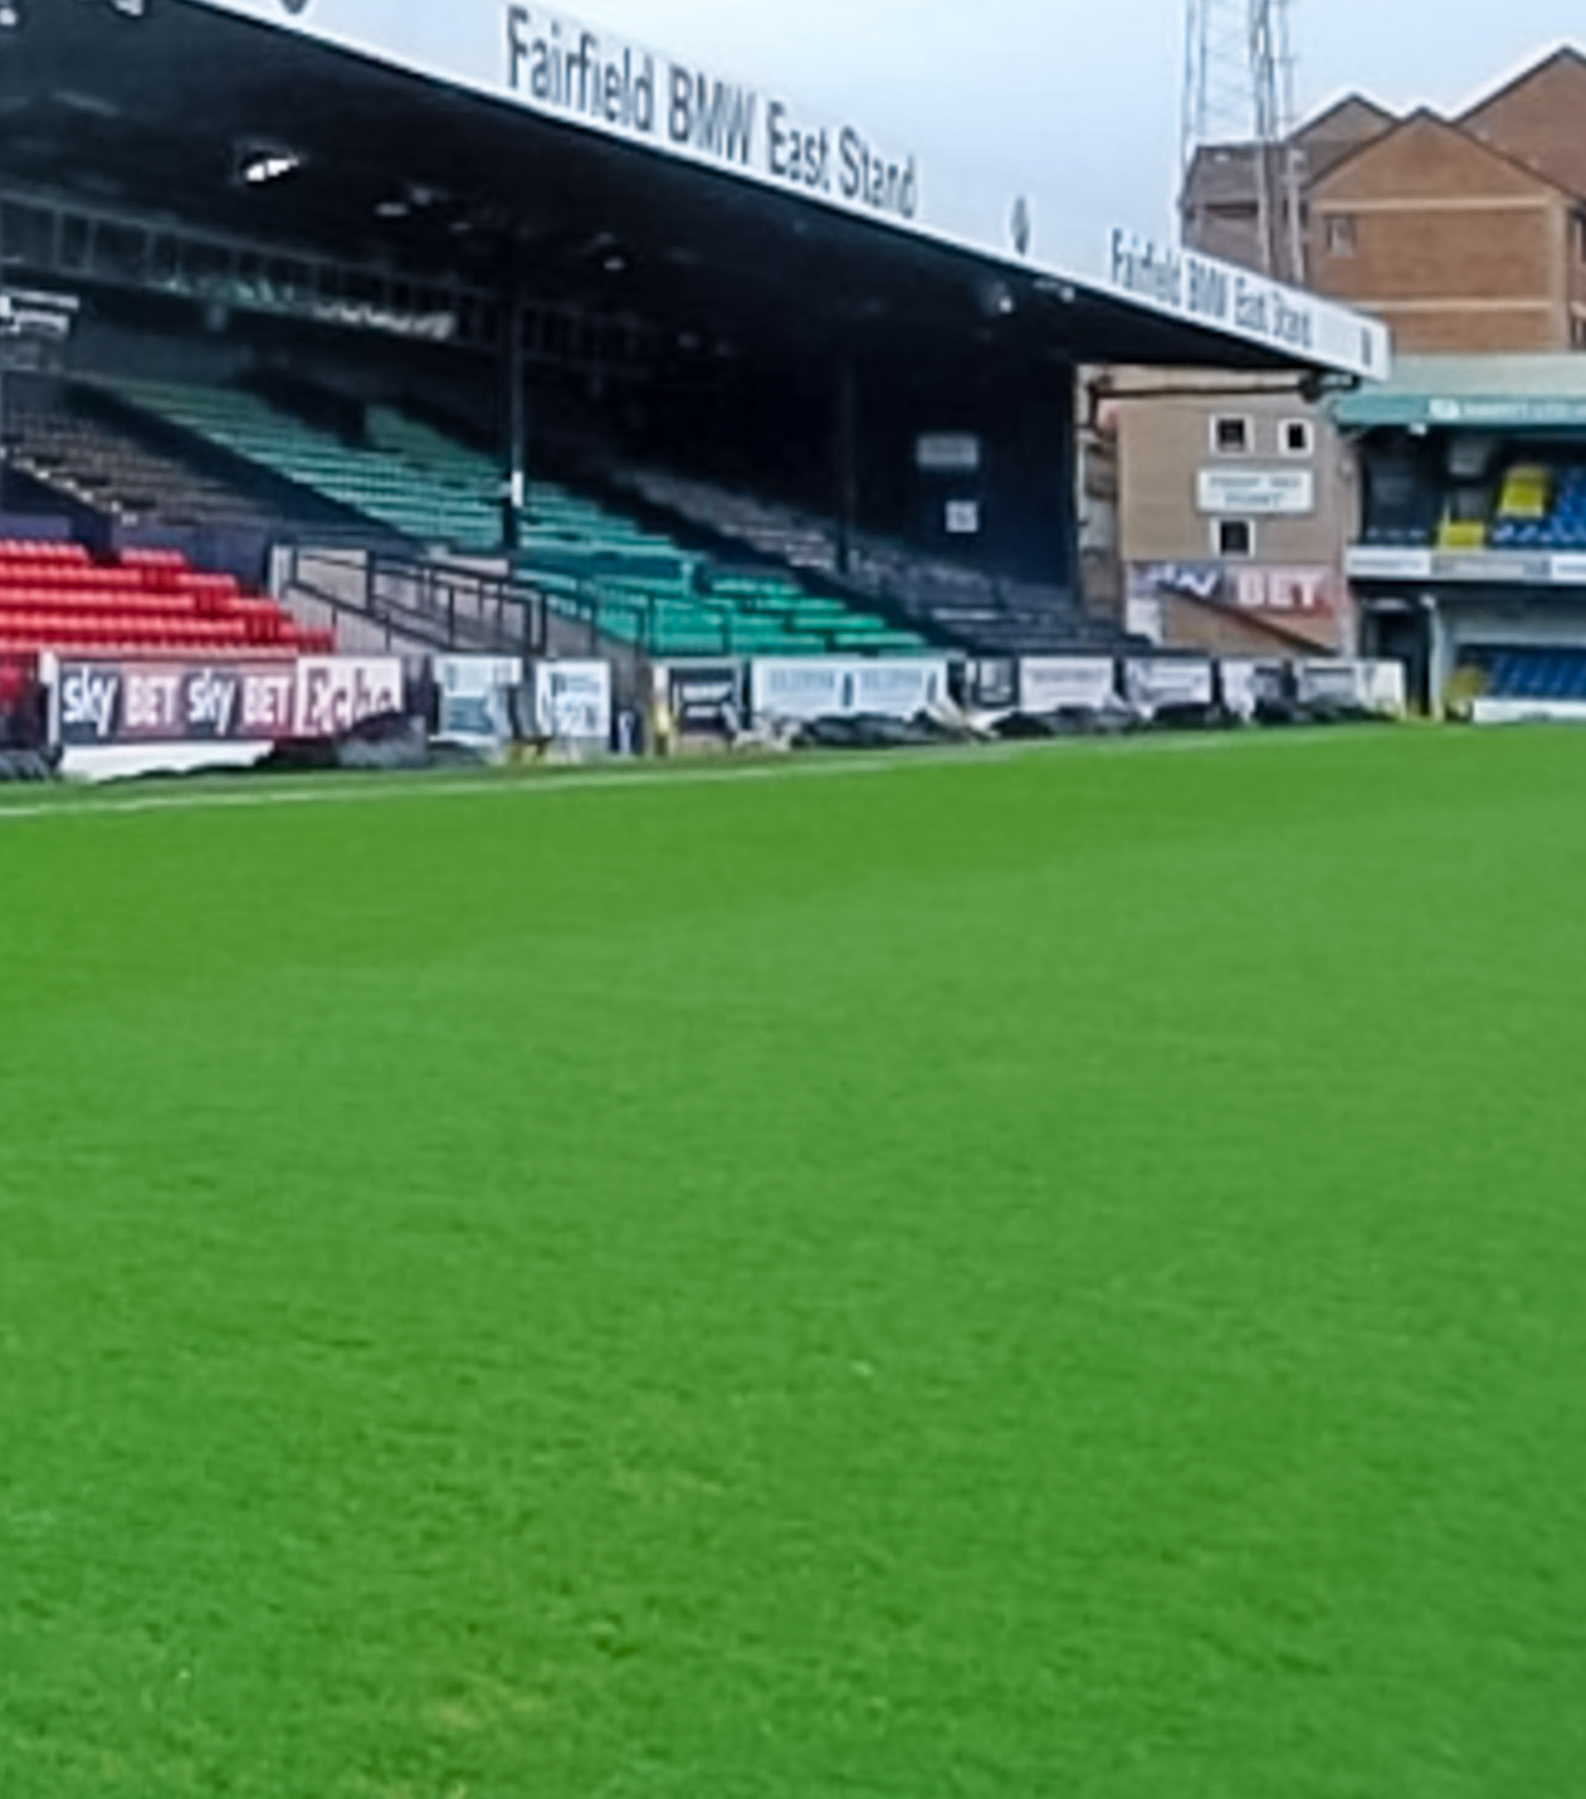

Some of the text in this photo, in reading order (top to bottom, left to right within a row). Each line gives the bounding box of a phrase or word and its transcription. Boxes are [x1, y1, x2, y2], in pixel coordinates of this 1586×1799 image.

[507, 4, 917, 219] Fairfield BMW East Stand
[127, 675, 178, 726] BET
[243, 675, 290, 722] BET
